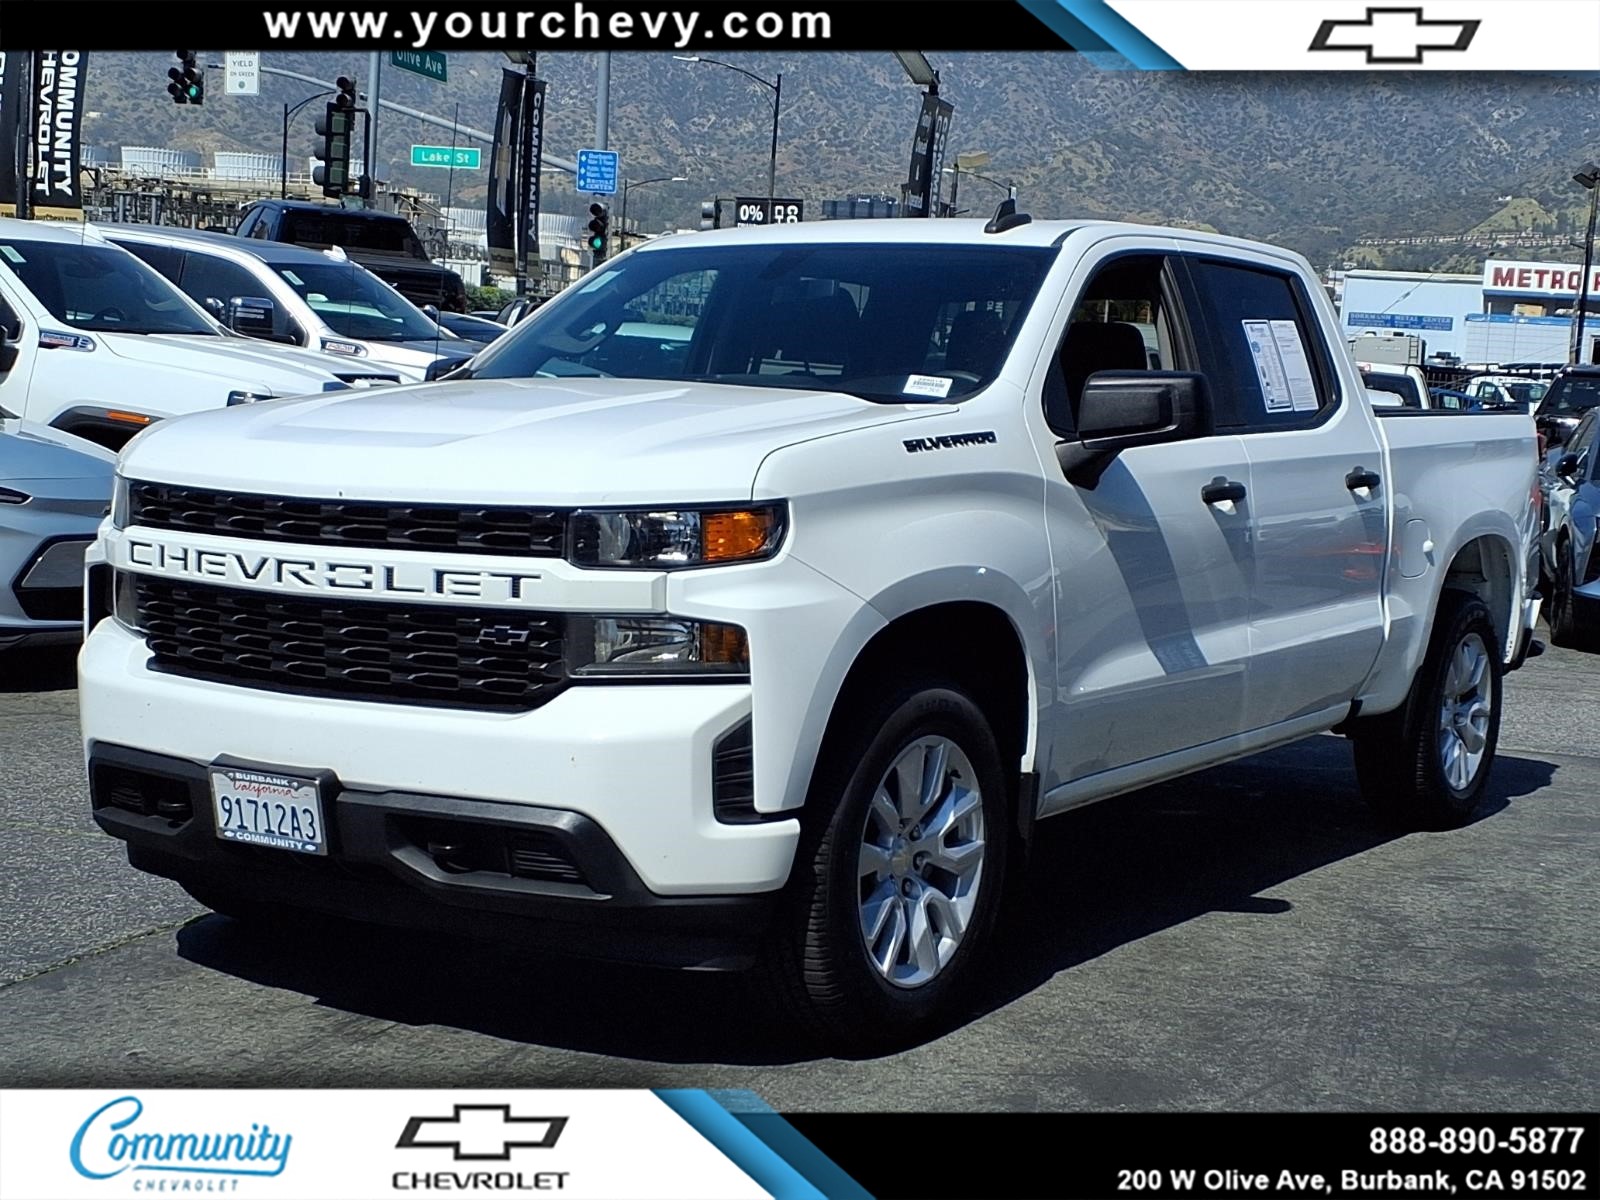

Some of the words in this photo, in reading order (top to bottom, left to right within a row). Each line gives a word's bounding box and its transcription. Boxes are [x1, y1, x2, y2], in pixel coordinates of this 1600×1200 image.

[397, 50, 420, 67] Olive
[425, 55, 442, 74] Ave
[421, 151, 450, 163] Lake
[456, 153, 469, 164] St
[528, 92, 542, 242] COMMUNITY
[740, 204, 764, 221] 0%
[1492, 267, 1582, 291] METRO
[903, 431, 997, 453] SILVERADO
[128, 540, 541, 598] CHEVROLET
[236, 772, 289, 786] BURBANK
[221, 796, 316, 840] 91712A3
[236, 831, 303, 850] COMMUNITY
